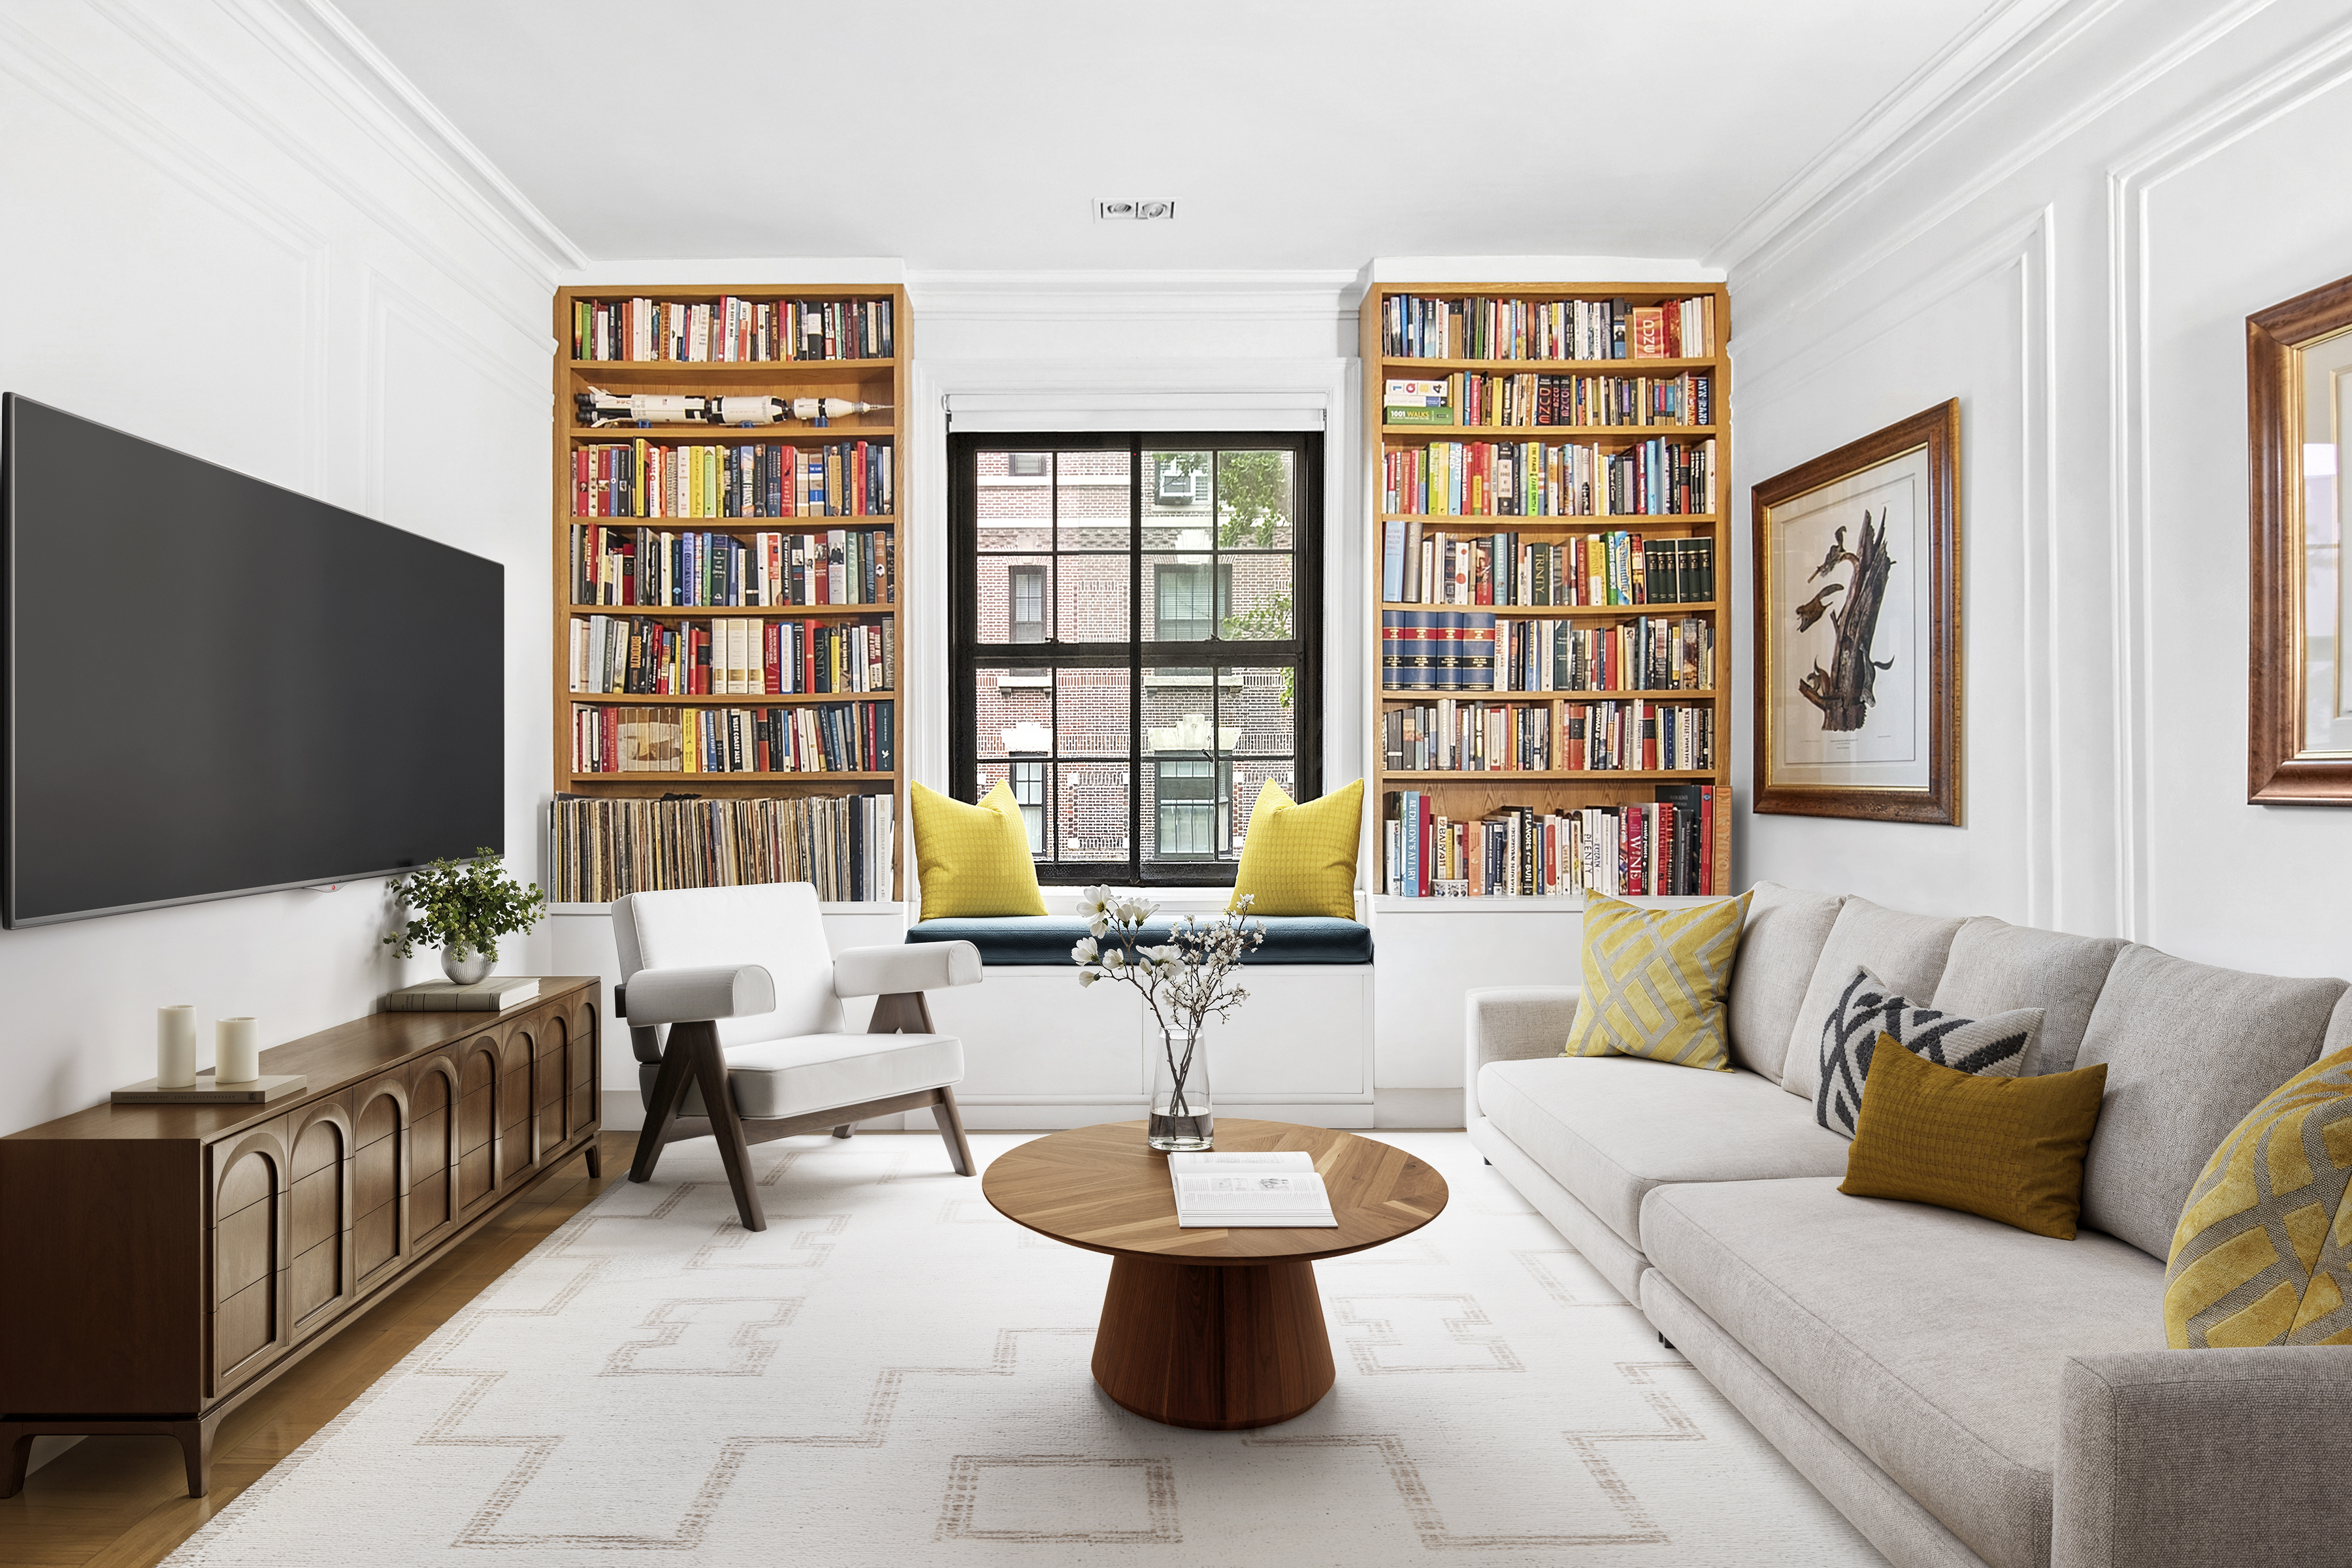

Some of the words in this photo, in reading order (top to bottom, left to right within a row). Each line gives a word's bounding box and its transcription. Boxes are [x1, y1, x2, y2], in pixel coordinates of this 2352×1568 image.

[1643, 320, 1656, 353] DUNE
[1539, 387, 1550, 423] DUNE
[743, 485, 753, 506] FRANZEN
[1535, 551, 1544, 593] TRINITY
[630, 636, 642, 668] BROOKLYN
[816, 636, 825, 678] TRINITY
